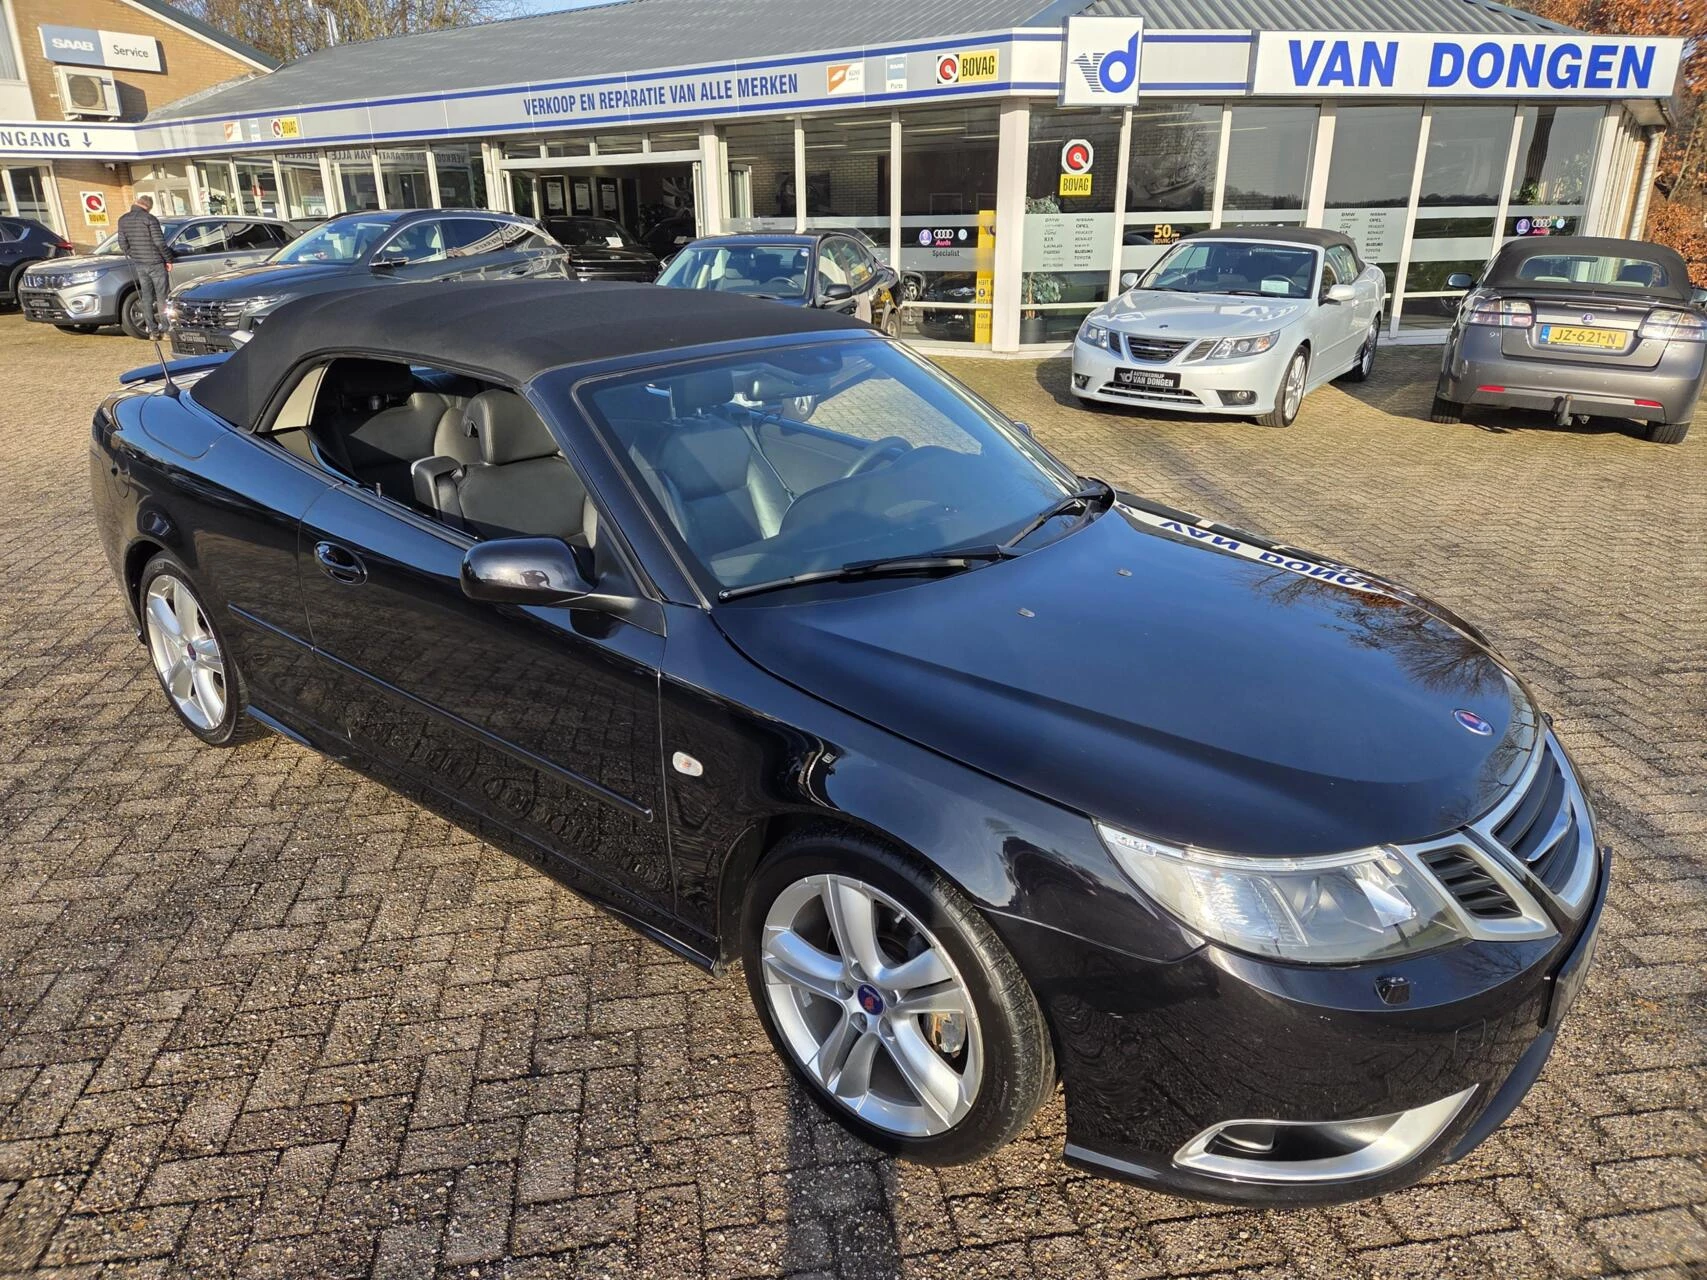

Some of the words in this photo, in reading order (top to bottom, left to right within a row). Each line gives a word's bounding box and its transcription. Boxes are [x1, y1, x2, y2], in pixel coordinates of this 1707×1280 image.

[51, 37, 94, 52] SAAB
[113, 45, 149, 58] Service
[961, 55, 995, 77] BOVAG
[1288, 39, 1399, 87] VAN
[1427, 41, 1656, 89] DONGEN
[523, 94, 576, 116] VERKOOP
[580, 93, 595, 111] EN
[599, 86, 666, 109] REPARATIE
[669, 83, 696, 104] VAN
[700, 79, 732, 101] ALLE
[737, 73, 798, 98] MERKEN
[0, 131, 70, 147] NGANG
[1063, 176, 1089, 192] BOVAG
[1154, 224, 1172, 238] 50
[932, 249, 960, 258] Specialist
[1554, 329, 1618, 345] JZ-621-N
[1132, 376, 1146, 384] VAN
[1146, 377, 1174, 387] DONGEN
